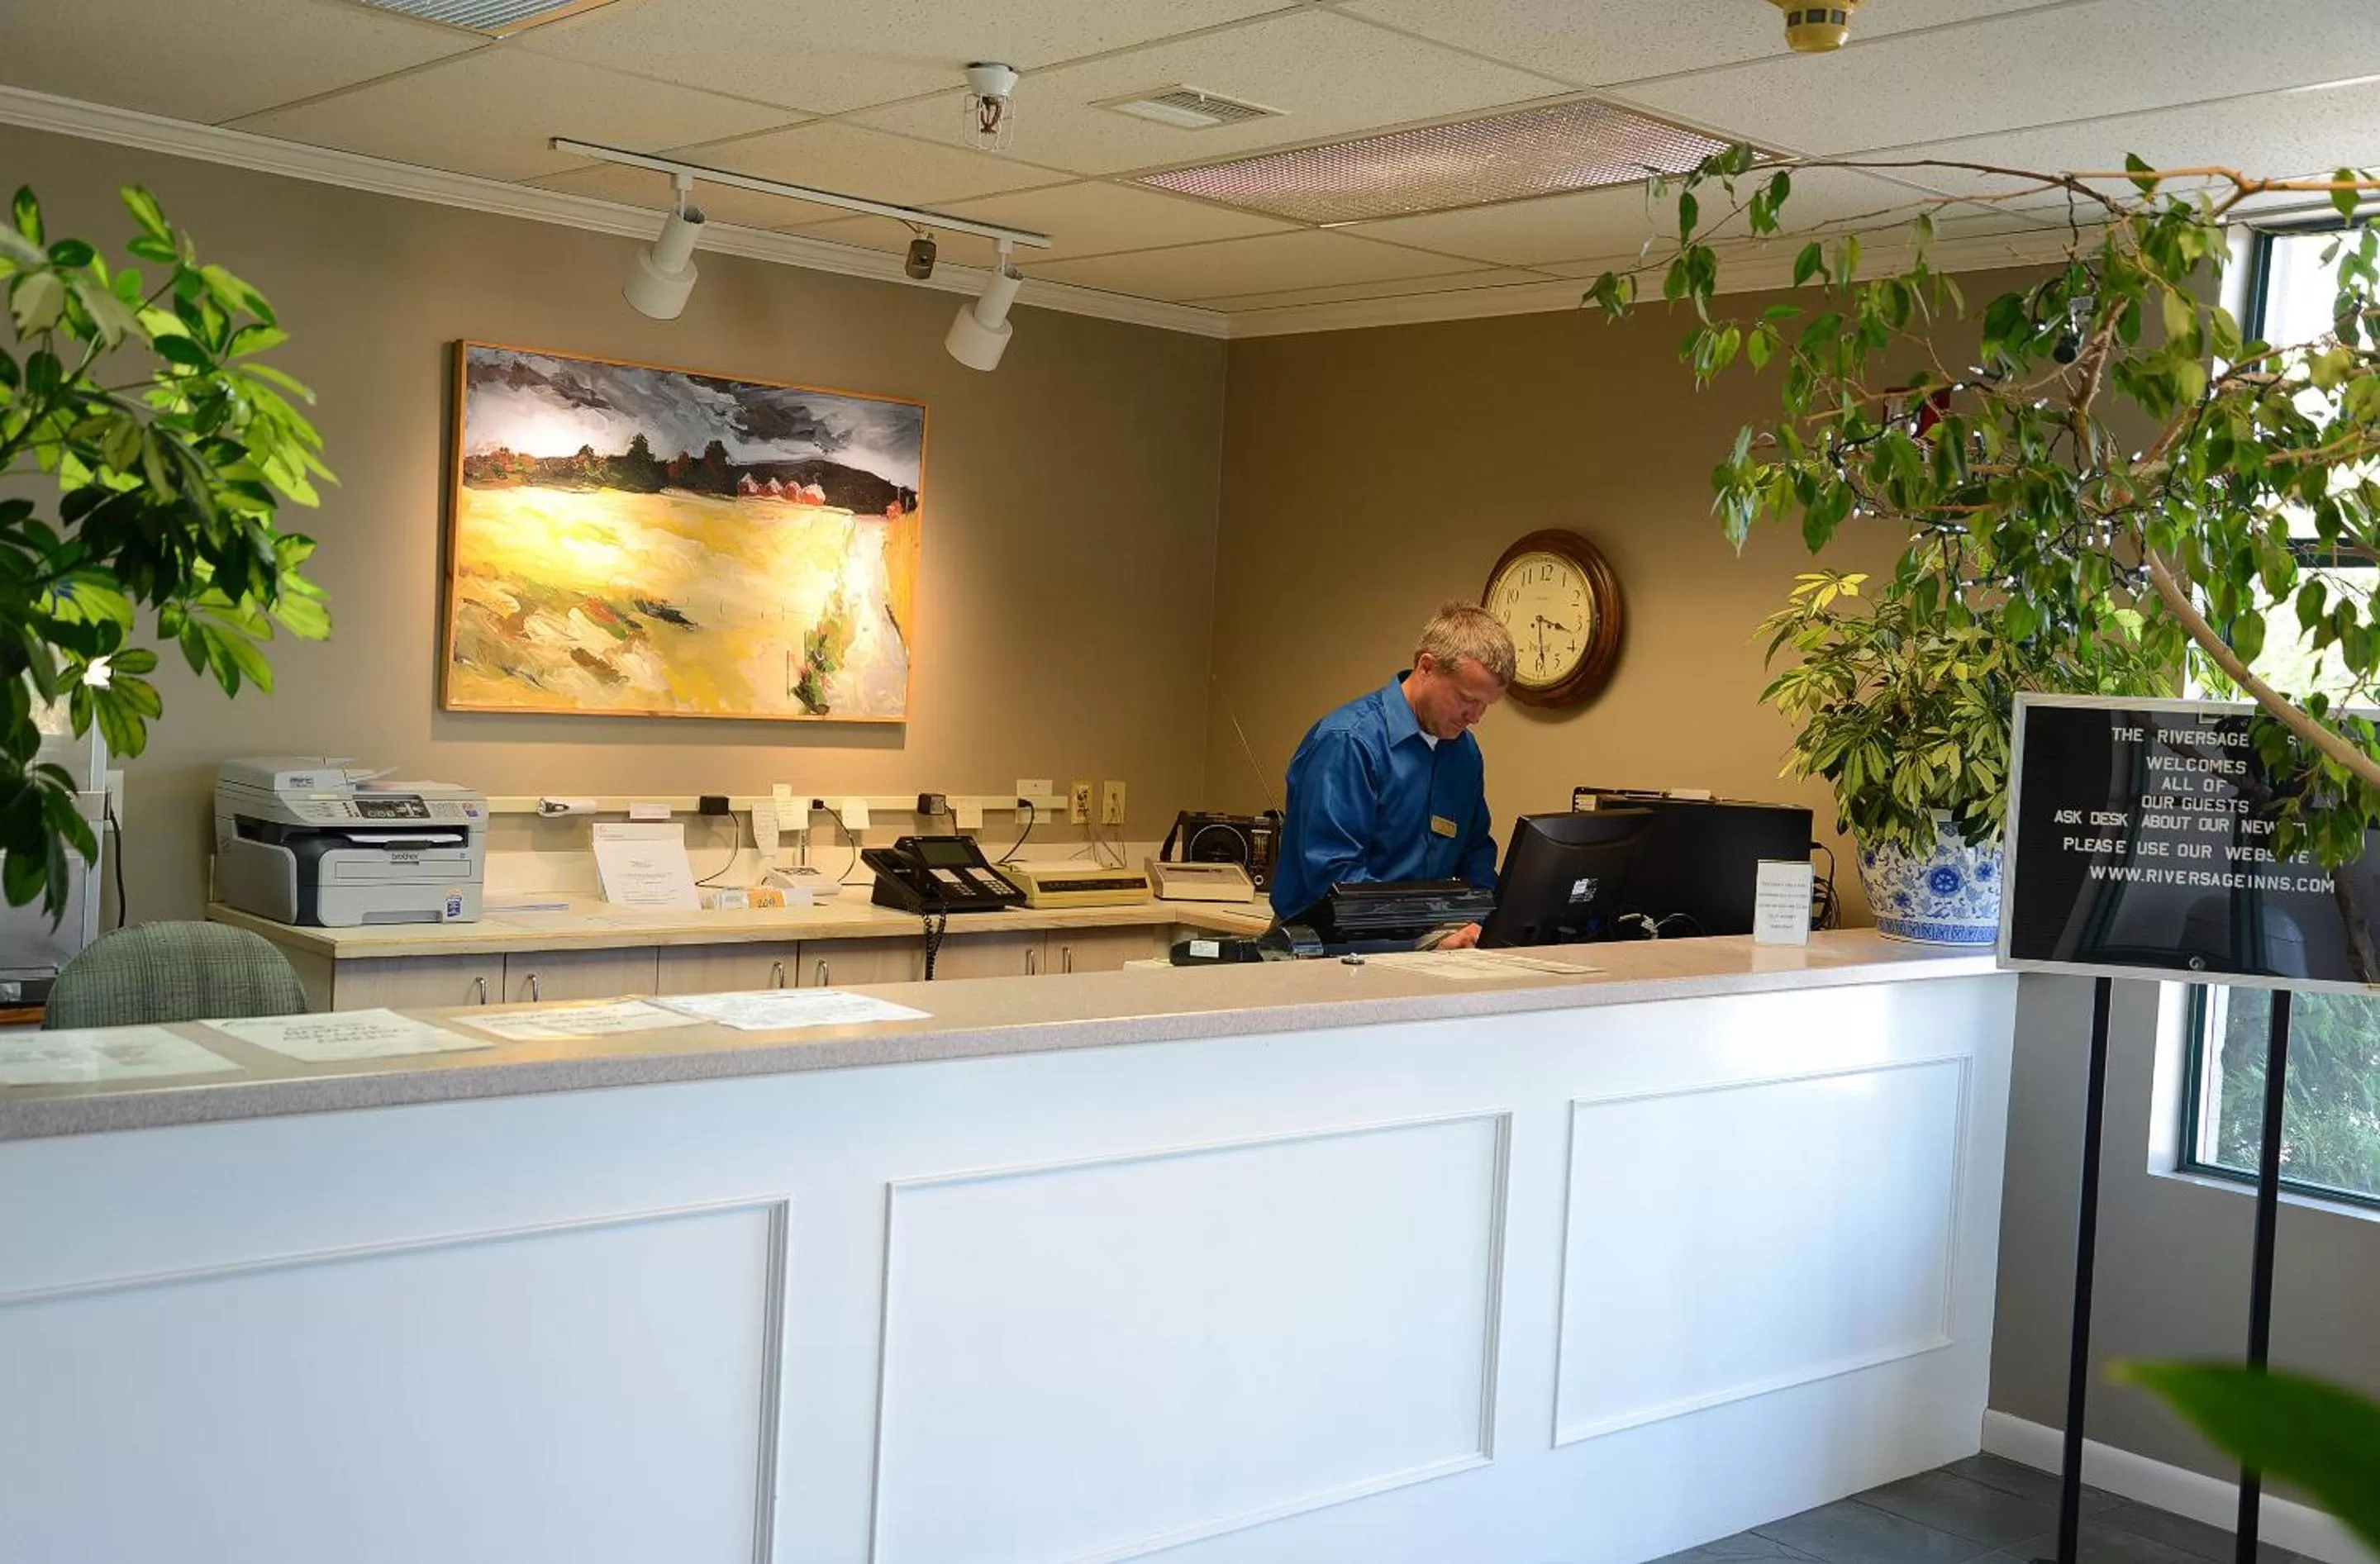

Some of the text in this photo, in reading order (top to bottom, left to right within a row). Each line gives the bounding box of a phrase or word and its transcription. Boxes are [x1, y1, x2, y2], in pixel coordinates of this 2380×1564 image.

[1521, 568, 1532, 587] 11
[1540, 564, 1554, 582] 12
[1562, 571, 1567, 587] 1
[1507, 587, 1520, 605] 10
[1571, 589, 1581, 606] 2
[1574, 613, 1583, 632] 3
[1566, 639, 1577, 654] 4
[1553, 653, 1561, 670] 5
[2111, 727, 2249, 748] THE RIVERSAGE
[2146, 756, 2247, 774] WELCOMES
[2161, 777, 2228, 793] ALL OF
[2141, 795, 2249, 814] OUR GUESTS
[2054, 810, 2082, 825] ASK
[2090, 811, 2129, 826] DESK
[2141, 815, 2192, 830] ABOUT
[2198, 817, 2230, 833] OUR
[2241, 820, 2278, 835] NEW
[2063, 837, 2310, 864] PLEASE USE OUR WEBSTE
[2089, 866, 2335, 894] WWW.RIVERSAGEINNS.COM
